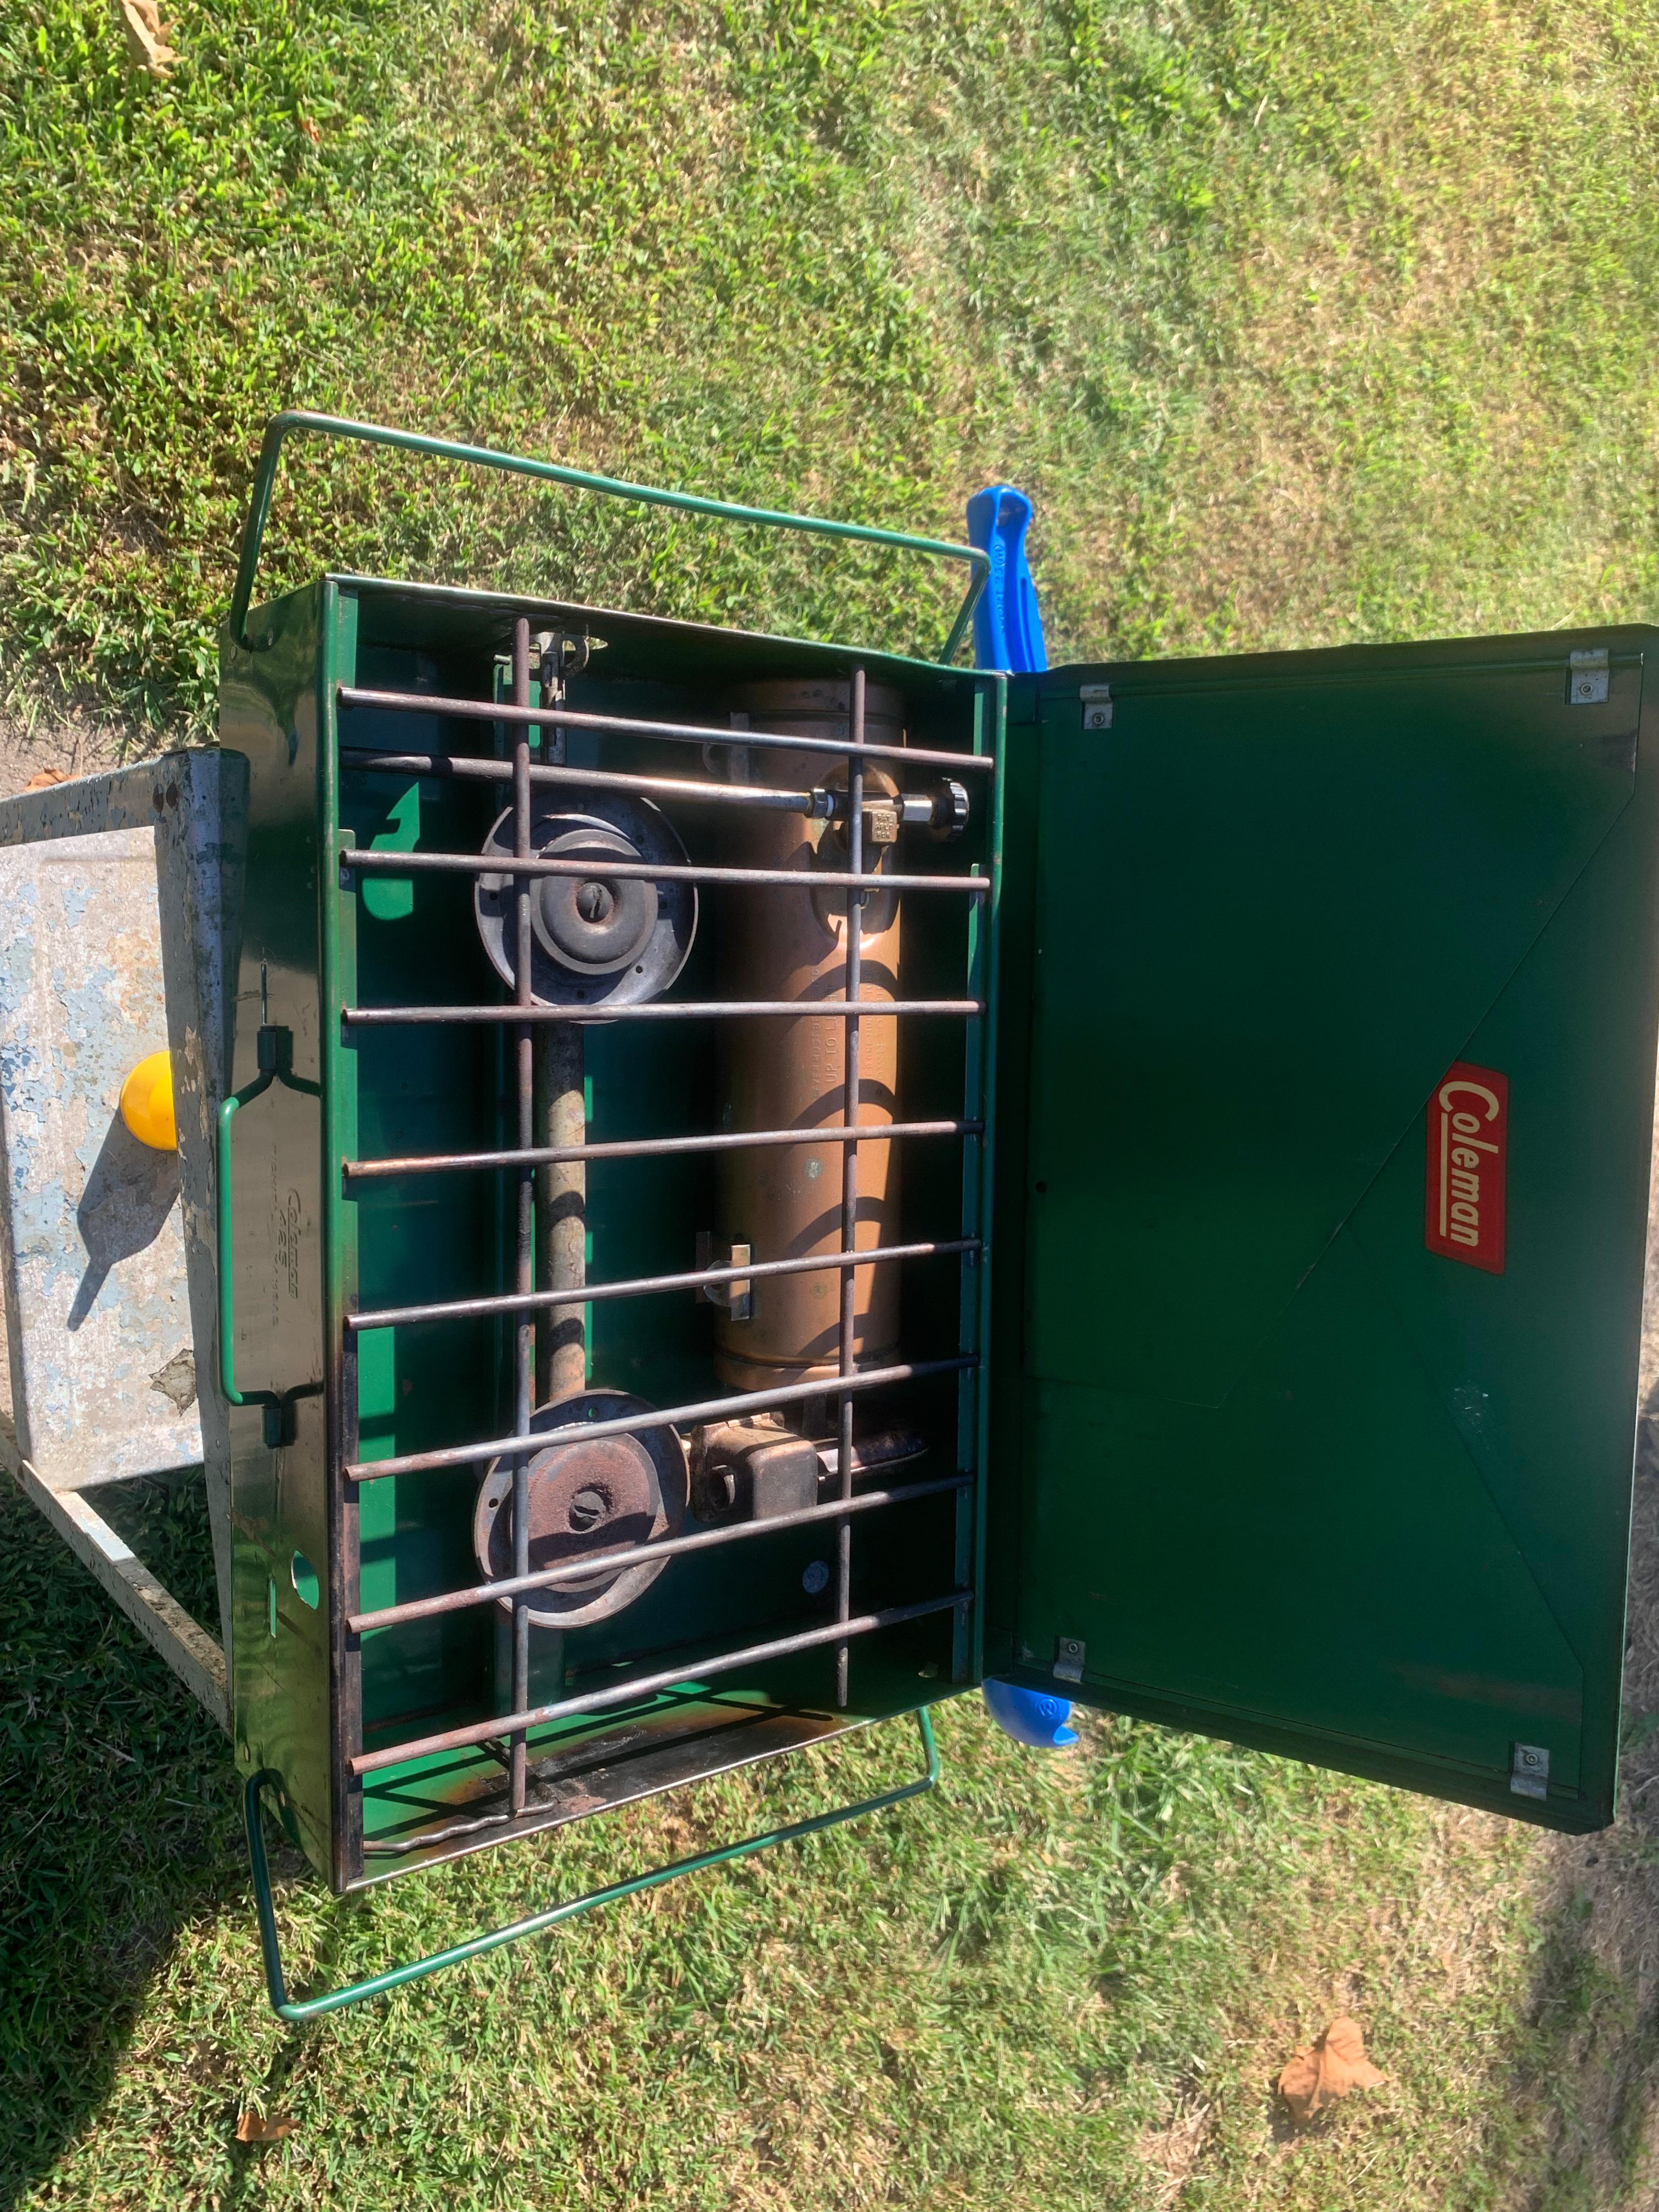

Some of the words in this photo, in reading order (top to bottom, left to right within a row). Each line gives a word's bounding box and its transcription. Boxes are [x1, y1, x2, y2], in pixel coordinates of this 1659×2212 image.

[876, 831, 890, 839] FOR
[825, 984, 838, 1032] LIHT
[825, 1036, 838, 1058] TO
[825, 1063, 838, 1083] UP
[1438, 1081, 1499, 1246] Coleman
[278, 1209, 287, 1268] 425
[287, 1188, 301, 1300] Coleman
